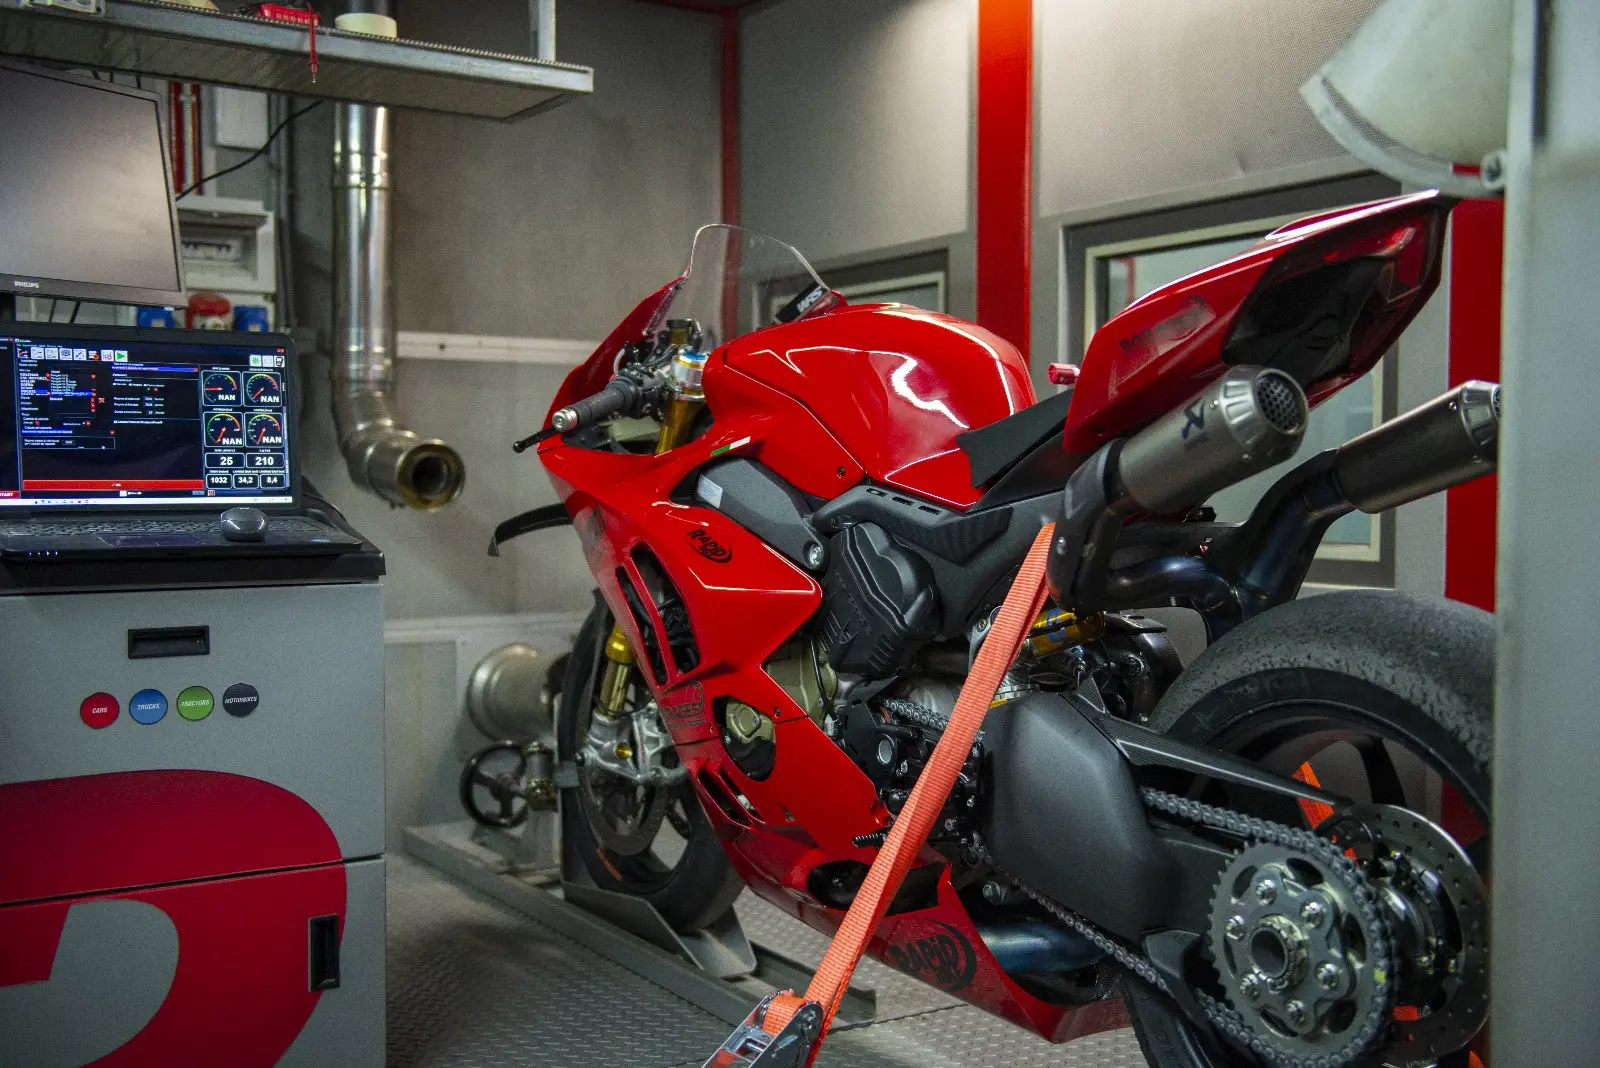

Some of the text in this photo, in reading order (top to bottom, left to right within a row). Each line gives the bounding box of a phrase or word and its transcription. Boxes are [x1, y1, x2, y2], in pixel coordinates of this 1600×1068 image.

[14, 280, 40, 289] PHILIPS
[260, 395, 280, 403] NAN
[222, 437, 243, 445] NAN
[220, 456, 234, 466] 25
[255, 456, 274, 466] 210
[210, 476, 228, 484] 1032
[238, 476, 254, 485] 34,2
[266, 476, 278, 485] 8,4
[137, 703, 160, 711] TRUCKS
[181, 699, 210, 707] TRACTORS
